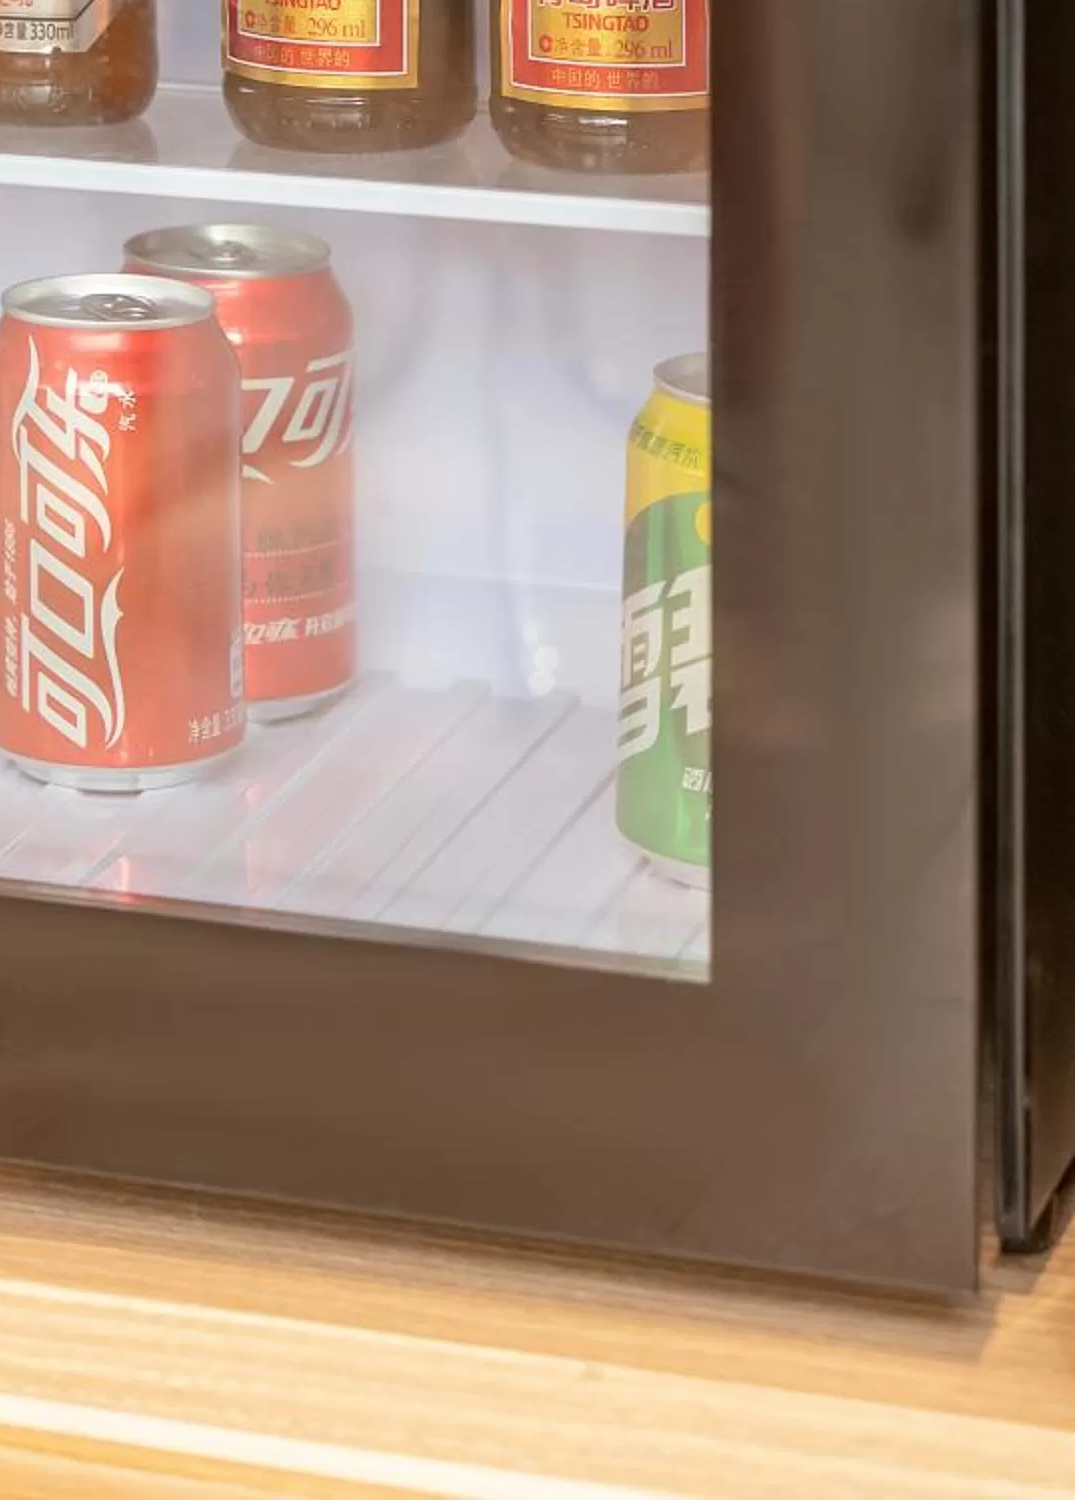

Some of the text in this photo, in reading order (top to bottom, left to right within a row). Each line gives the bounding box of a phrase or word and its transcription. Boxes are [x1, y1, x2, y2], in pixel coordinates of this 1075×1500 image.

[561, 11, 650, 33] TSINGTAO
[11, 335, 114, 750] 可口可乐
